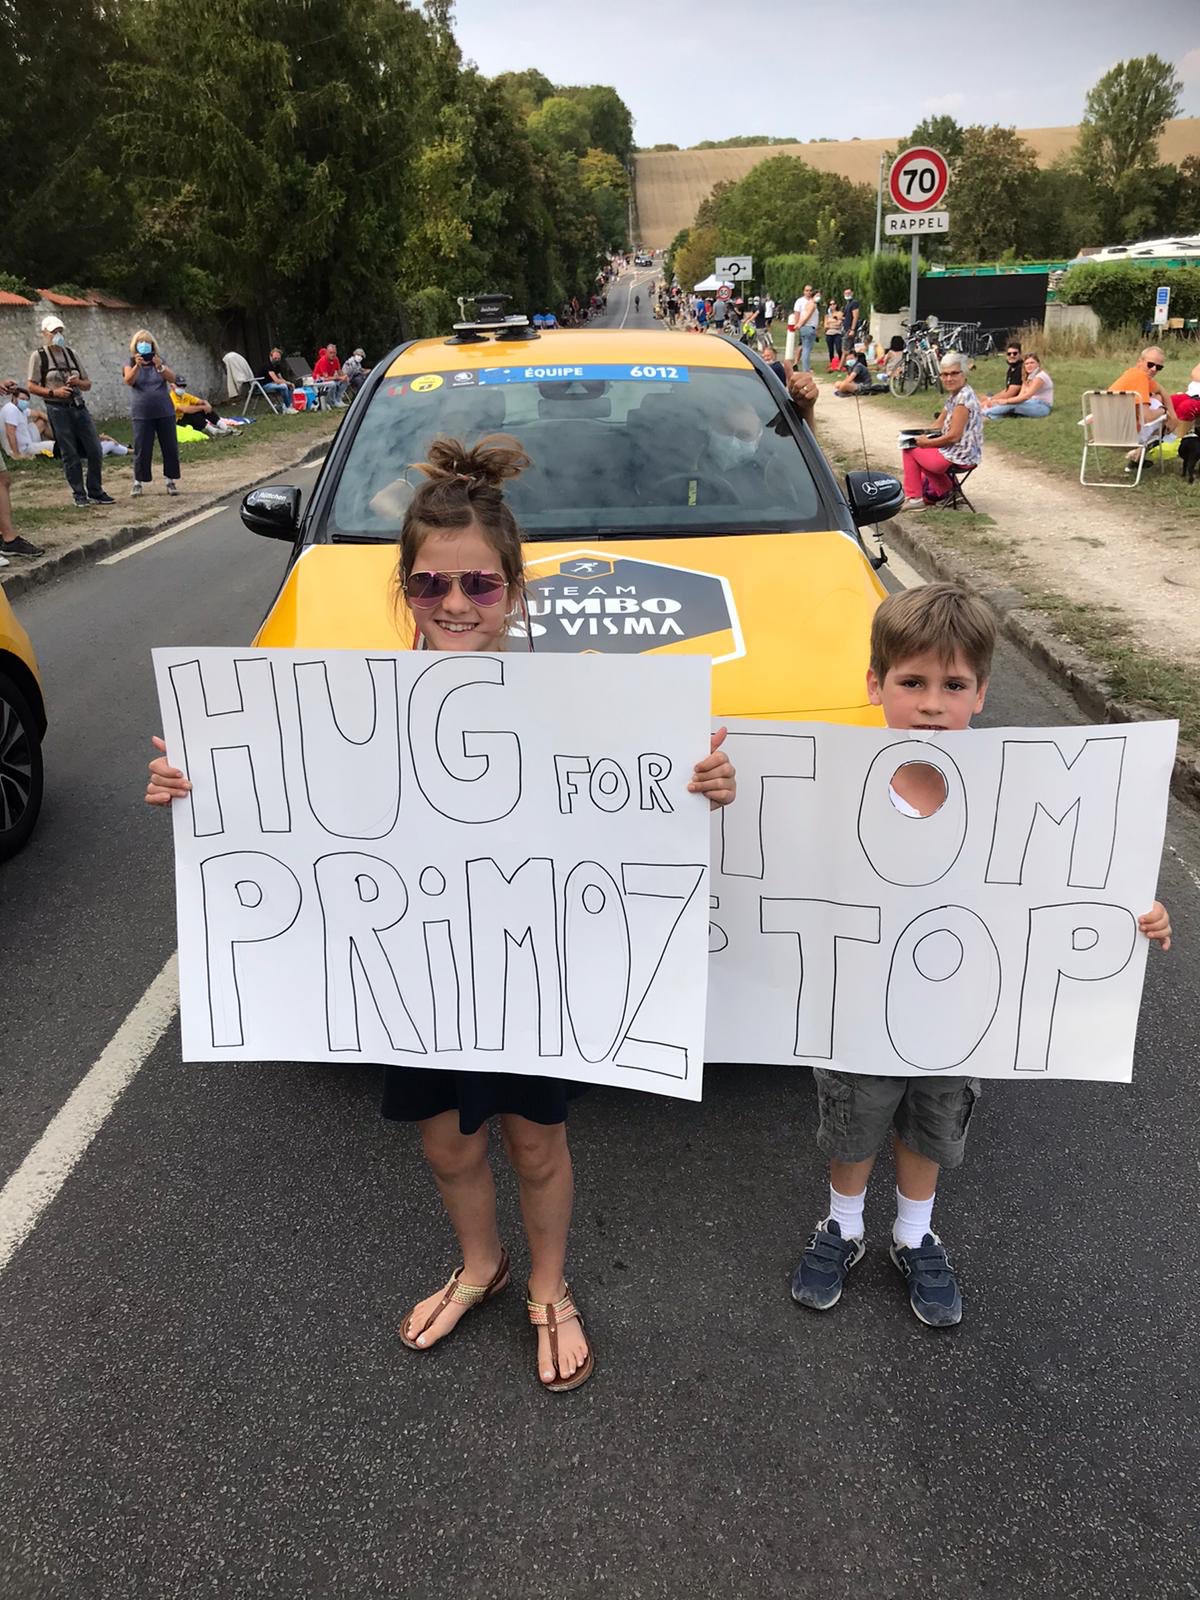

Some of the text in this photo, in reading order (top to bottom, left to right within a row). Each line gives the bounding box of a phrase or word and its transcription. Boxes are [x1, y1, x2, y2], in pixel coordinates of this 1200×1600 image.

[903, 168, 936, 195] 70
[890, 217, 943, 230] RAPPEL
[524, 366, 680, 379] ÉQUIPE 6012
[538, 585, 637, 597] TEAM
[559, 616, 685, 636] VISMA
[168, 656, 674, 840] HUG FOR
[711, 733, 1127, 889] TOM
